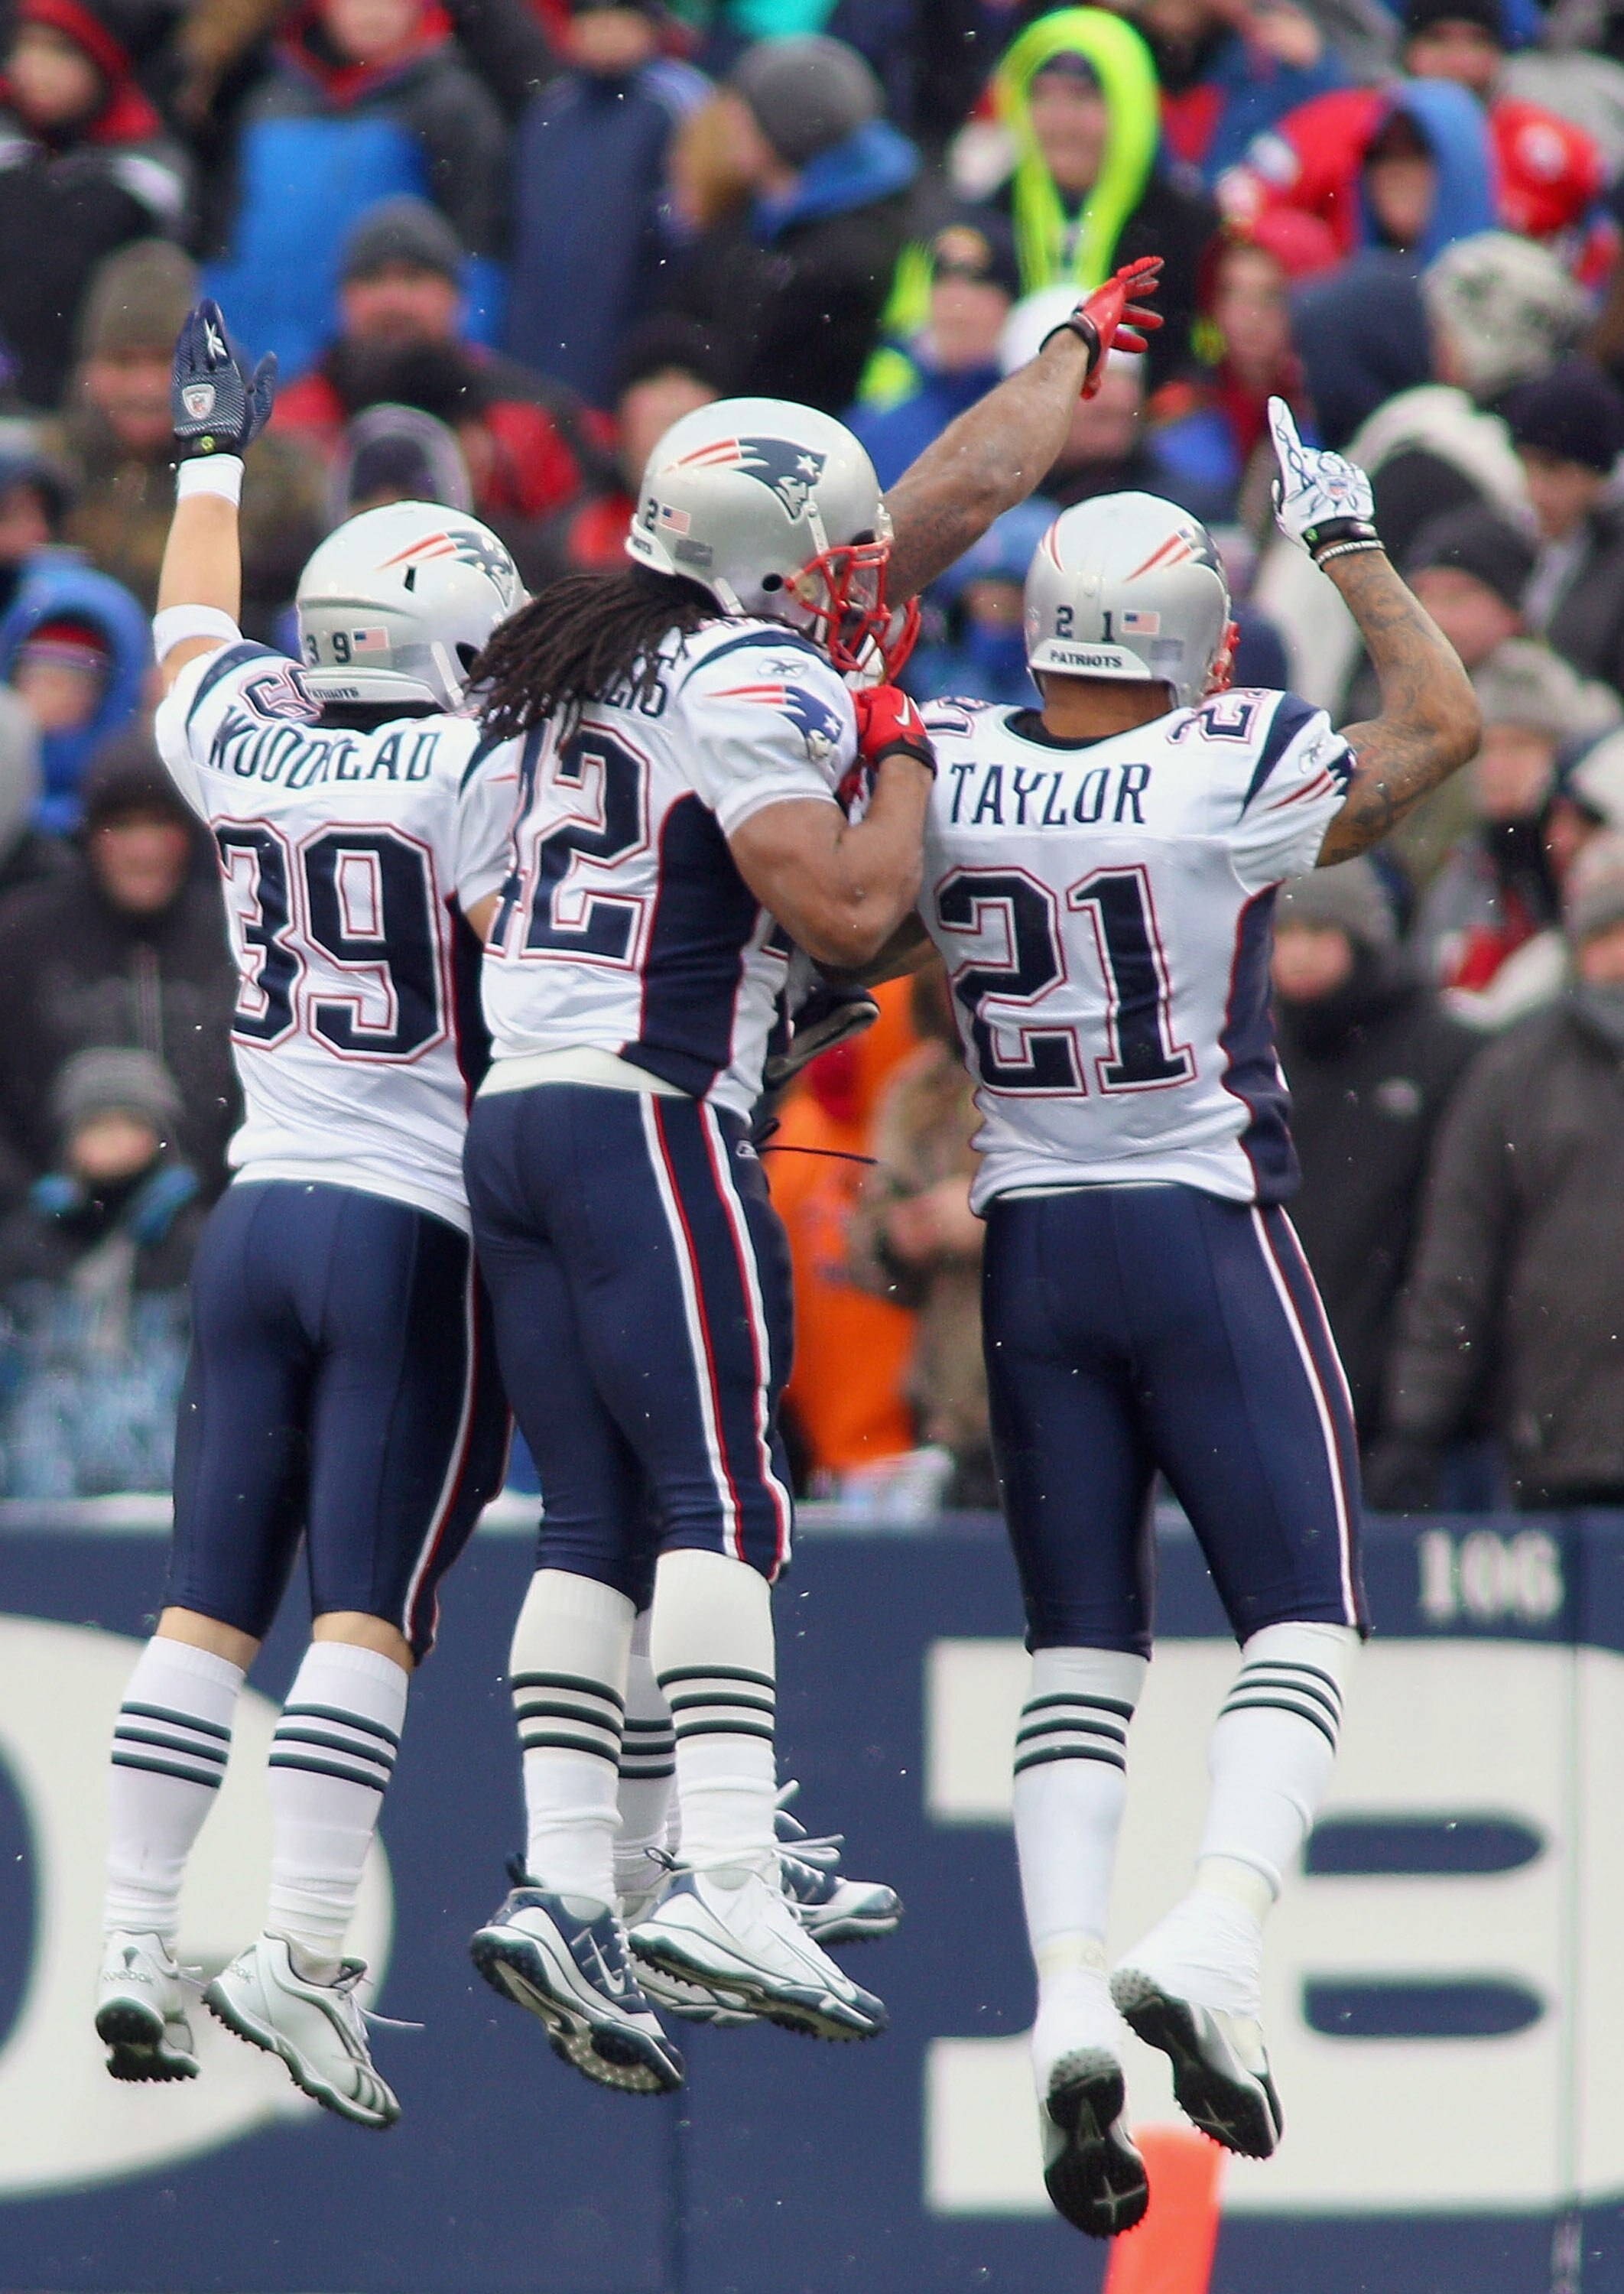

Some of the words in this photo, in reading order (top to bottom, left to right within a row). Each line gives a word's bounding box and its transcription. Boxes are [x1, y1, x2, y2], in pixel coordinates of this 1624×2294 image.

[645, 498, 658, 531] 2
[1050, 649, 1122, 668] PATRIOTS
[950, 763, 1152, 827] TAYLOR
[209, 814, 450, 1064] 39
[934, 864, 1198, 1097] 21
[1418, 1527, 1565, 1622] 106
